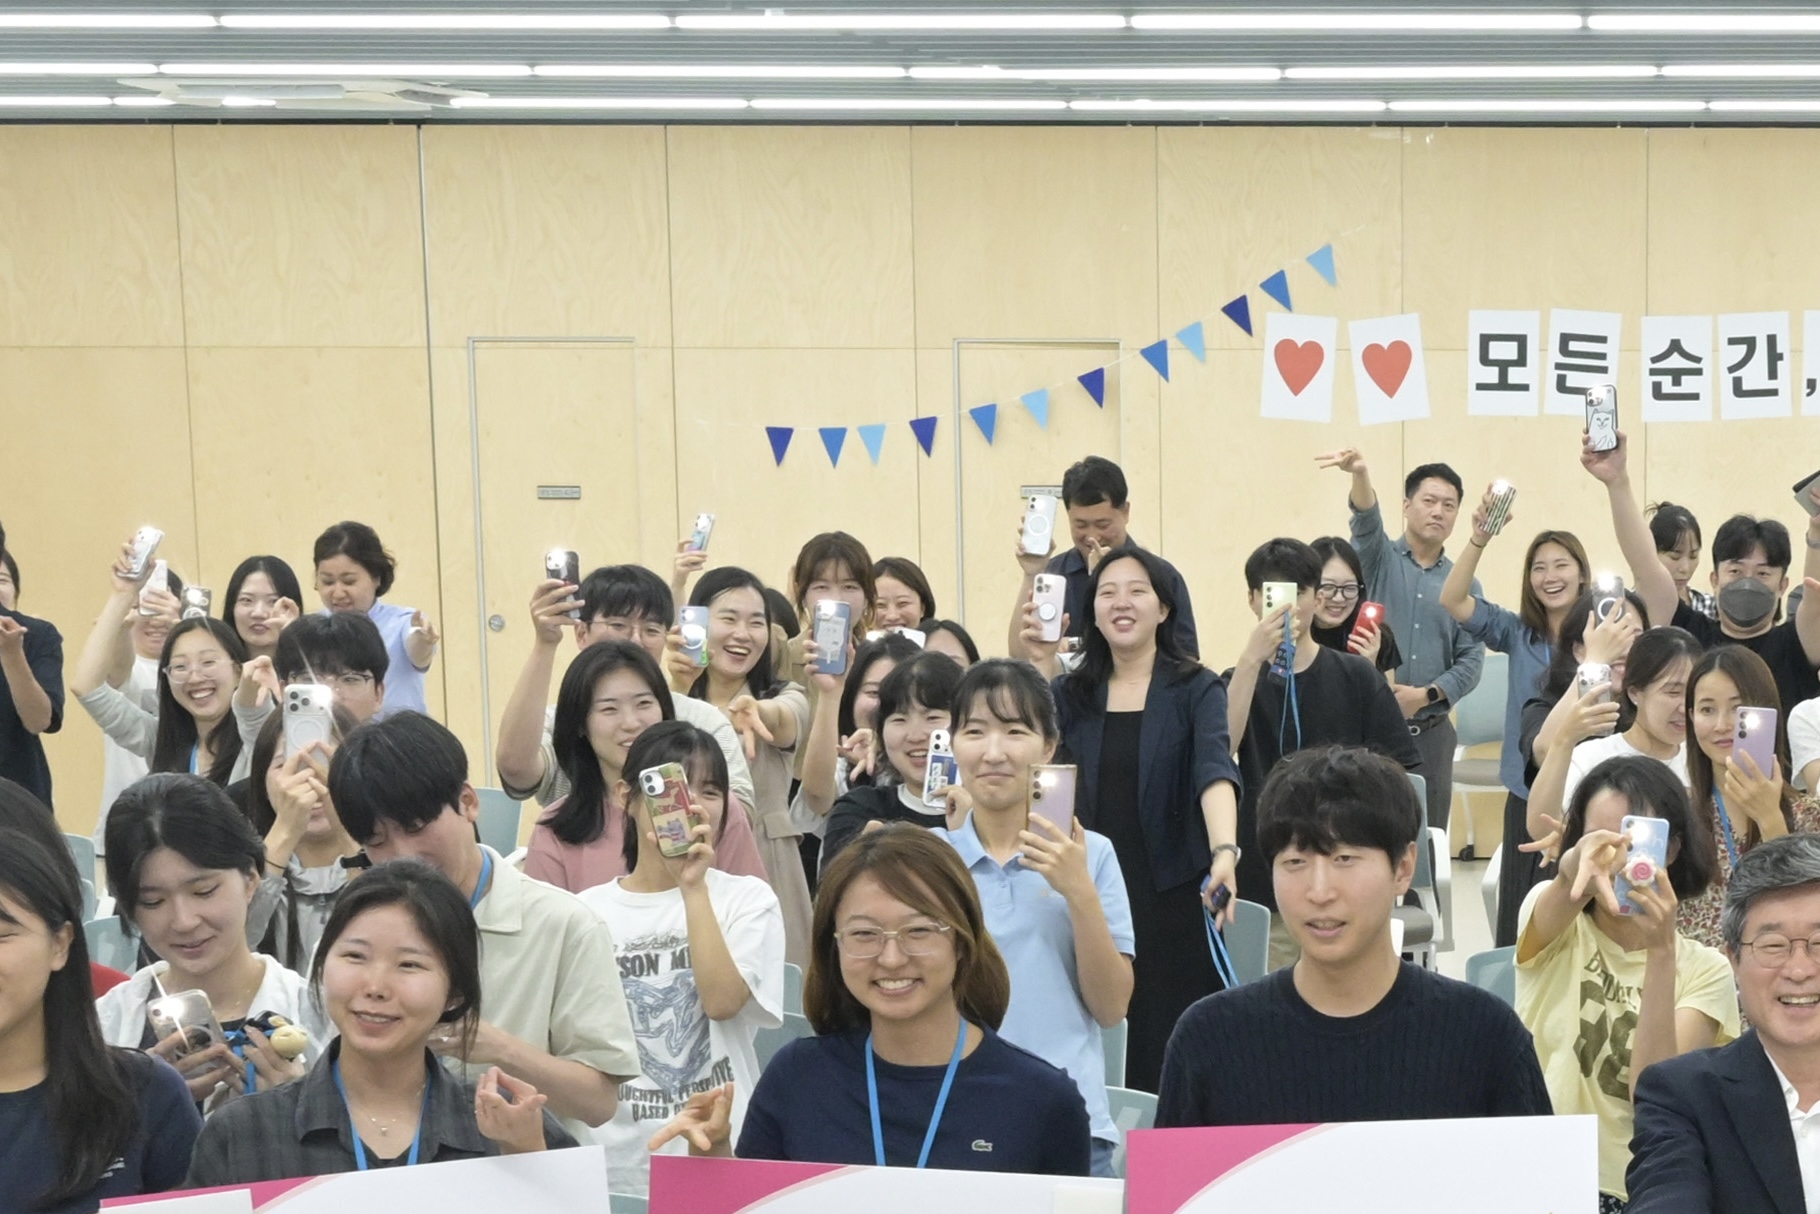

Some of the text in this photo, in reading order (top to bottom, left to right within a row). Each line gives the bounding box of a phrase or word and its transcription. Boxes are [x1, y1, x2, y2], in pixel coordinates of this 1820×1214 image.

[1475, 332, 1611, 396] 모든
[1649, 334, 1818, 401] 순간,
[616, 952, 660, 978] SON
[618, 1084, 674, 1104] OUGHTFUL
[632, 1103, 669, 1122] BASED
